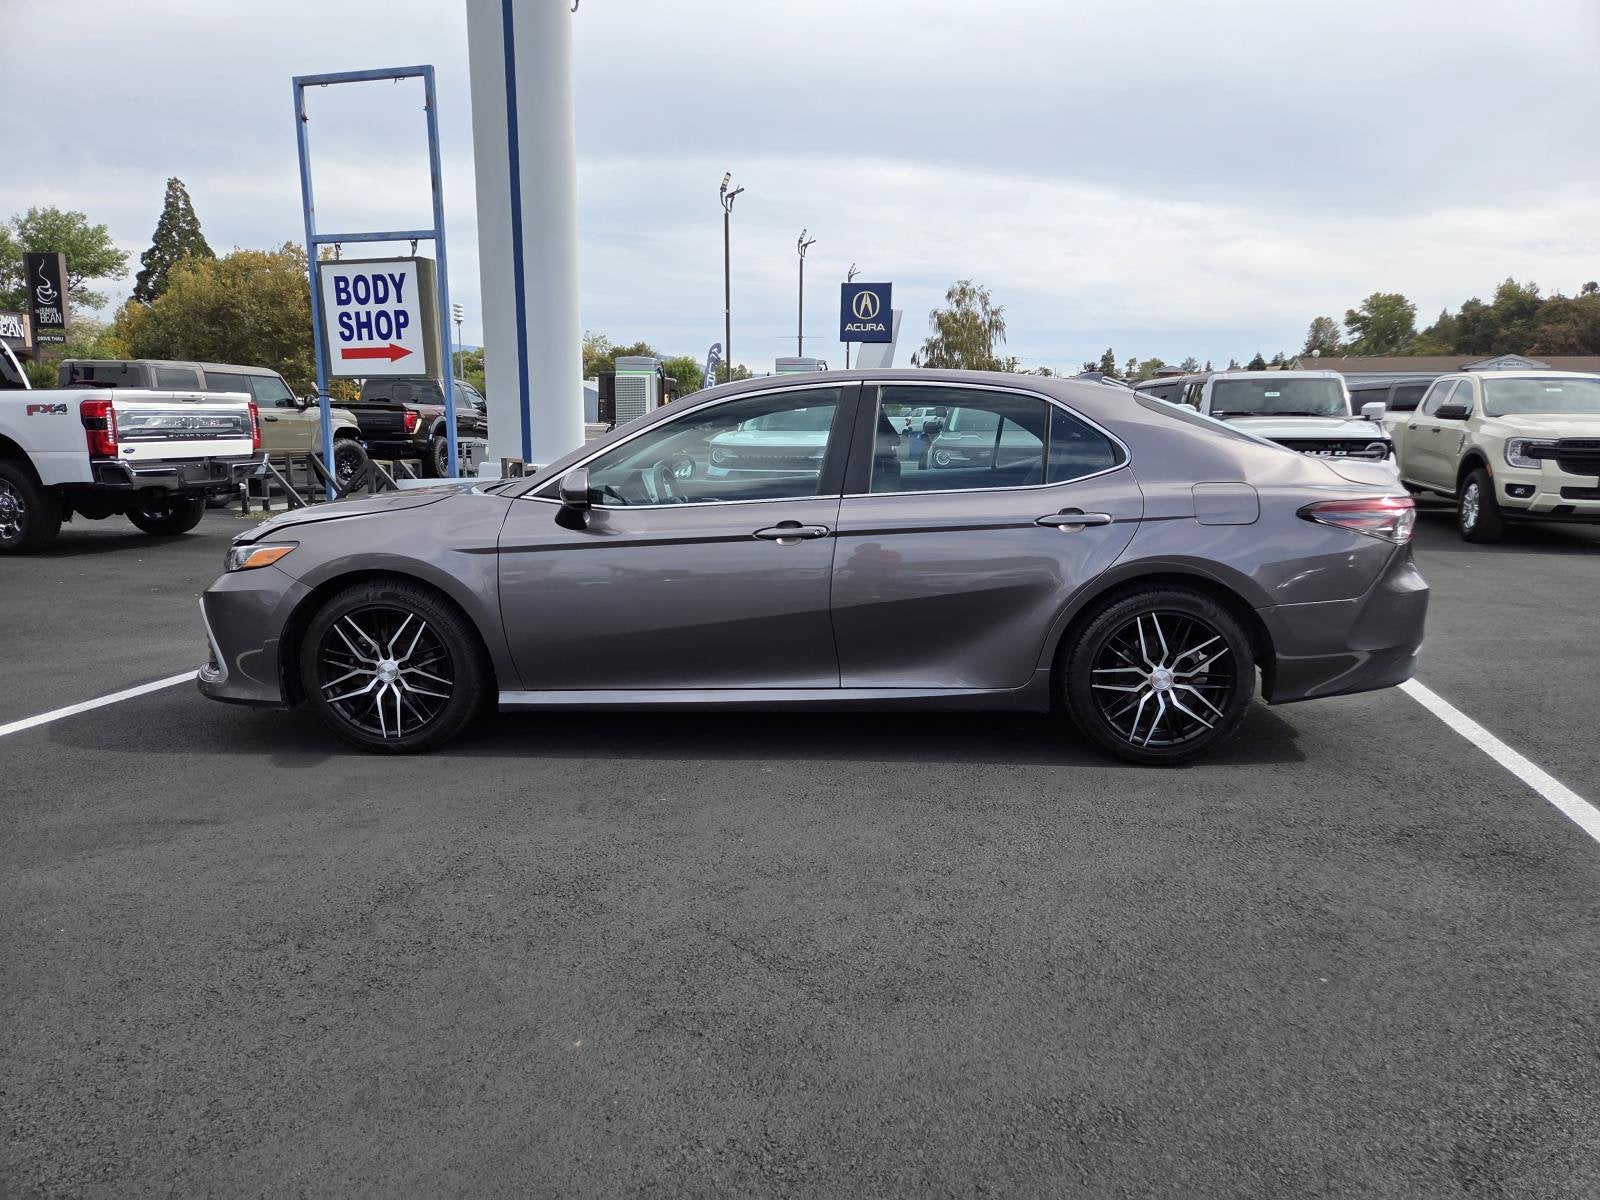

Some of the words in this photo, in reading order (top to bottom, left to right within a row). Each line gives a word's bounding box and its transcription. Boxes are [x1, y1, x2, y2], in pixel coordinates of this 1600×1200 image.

[333, 272, 406, 306] BODY
[40, 312, 62, 324] BEAN
[338, 309, 409, 341] SHOP
[0, 321, 25, 338] EAN
[844, 323, 885, 332] ACURA
[26, 403, 68, 416] FX4
